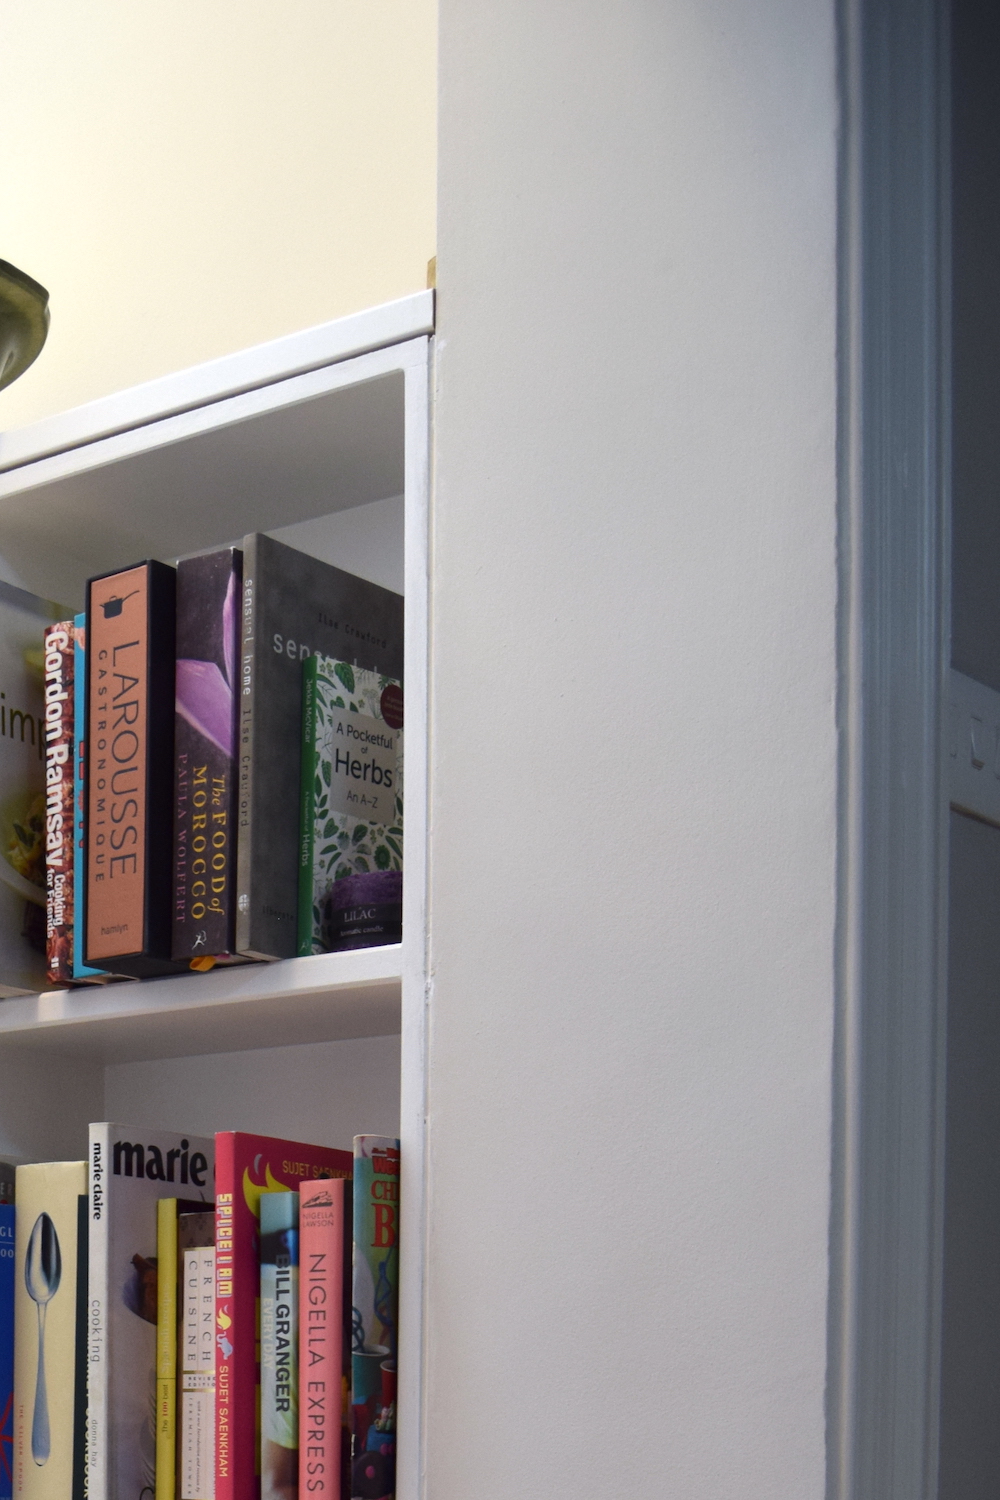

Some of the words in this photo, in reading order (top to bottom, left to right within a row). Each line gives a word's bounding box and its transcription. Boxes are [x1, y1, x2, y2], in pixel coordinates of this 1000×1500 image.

[243, 579, 253, 645] sensual
[45, 631, 69, 741] Gordon
[243, 655, 253, 696] home
[305, 679, 313, 704] Jekka
[242, 709, 251, 743] Ilse
[304, 706, 314, 743] McVicar
[336, 722, 343, 735] A
[347, 724, 393, 750] Pocketful
[95, 650, 108, 882] GASTRONOMIQUE
[109, 640, 140, 879] LAROUSSE
[335, 748, 393, 789] Herbs
[361, 745, 368, 754] of
[45, 745, 69, 867] Ramsay
[178, 753, 188, 820] PAULA
[211, 775, 226, 805] The
[240, 755, 251, 828] Crawford
[347, 790, 358, 803] An
[190, 765, 207, 919] MOROCCO
[211, 811, 227, 892] FOOD
[301, 834, 311, 867] Herbs
[175, 830, 187, 923] WOLFERT
[53, 874, 65, 926] Cooking
[208, 898, 225, 916] of
[344, 908, 376, 923] LILAC
[101, 923, 129, 936] hamlyn
[93, 1142, 104, 1182] marie
[113, 1138, 208, 1187] marie
[282, 1160, 310, 1176] SUJET
[93, 1183, 104, 1220] claire
[302, 1211, 335, 1219] NIGELLA
[216, 1193, 233, 1252] SPICE
[302, 1219, 335, 1227] LAWSON
[216, 1256, 233, 1264] I
[275, 1254, 290, 1301] BILL
[216, 1268, 233, 1298] AM
[187, 1260, 198, 1361] CUISINE
[202, 1260, 213, 1361] FRENCH
[308, 1253, 327, 1367] NIGELLA
[89, 1299, 101, 1363] cooking
[275, 1304, 290, 1412] GRANGER
[219, 1366, 229, 1404] SUJET
[91, 1419, 99, 1447] donna
[219, 1408, 229, 1477] SAENKHAM
[307, 1381, 325, 1492] EXPRESS
[90, 1450, 99, 1468] hay
